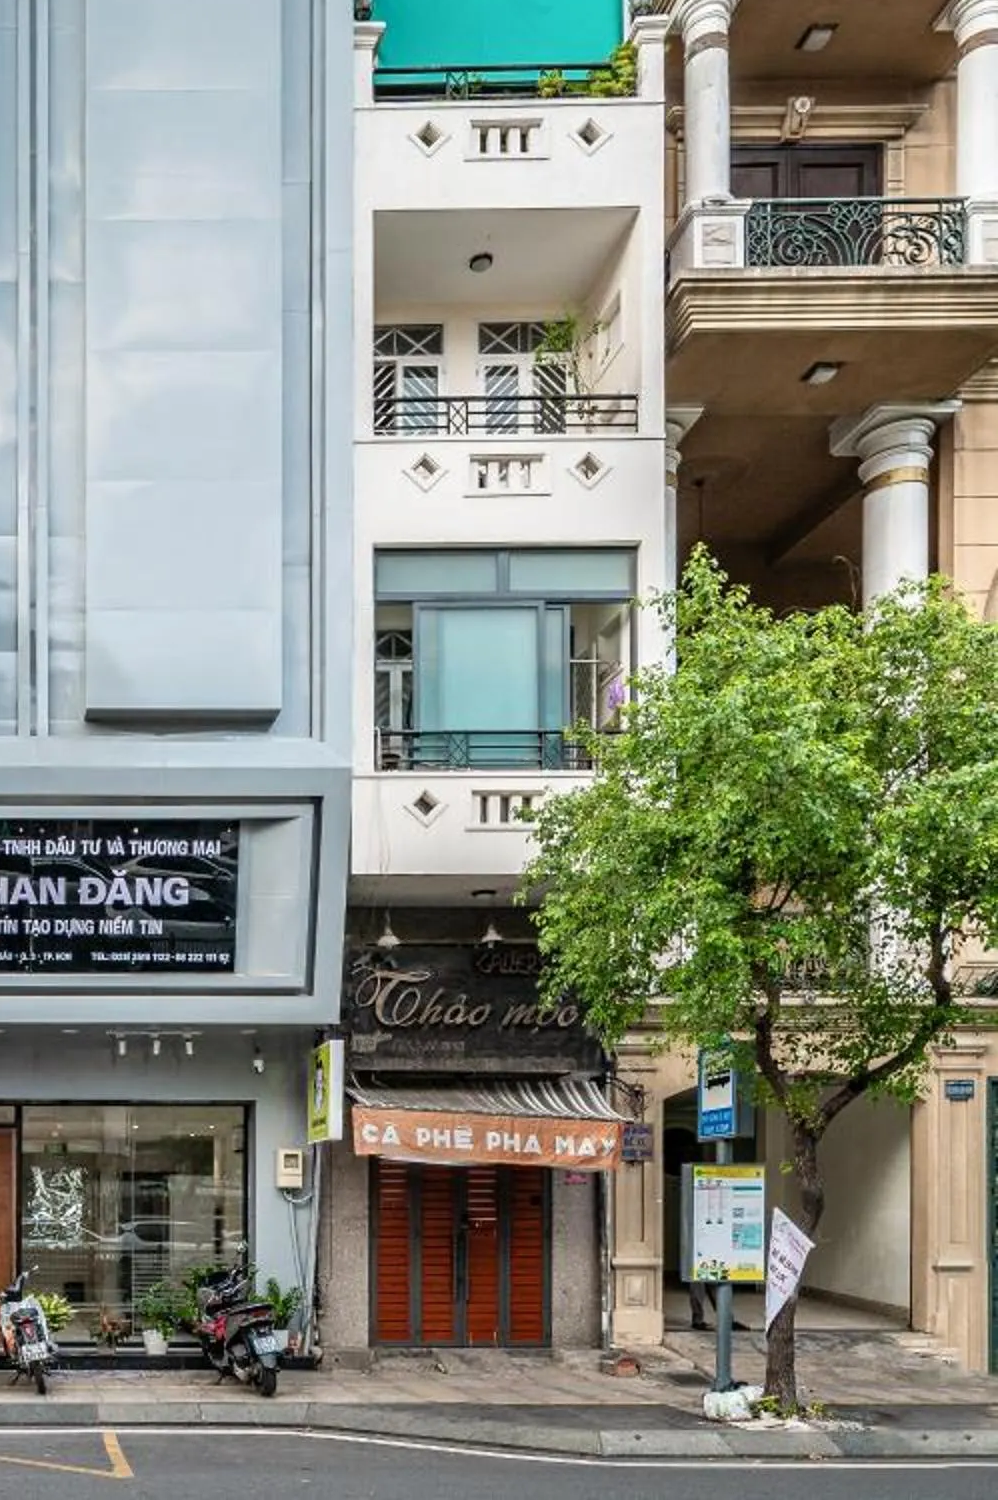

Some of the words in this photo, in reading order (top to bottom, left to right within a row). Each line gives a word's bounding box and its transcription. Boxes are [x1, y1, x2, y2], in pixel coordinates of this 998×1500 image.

[2, 840, 40, 855] TNHH
[45, 836, 75, 856] ĐẦU
[81, 838, 102, 856] TƯ
[107, 836, 125, 856] VÀ
[129, 838, 188, 856] THƯƠNG
[77, 869, 190, 907] ĐĂNG
[25, 919, 51, 937] TẠO
[54, 919, 94, 938] DỰNG
[139, 919, 163, 935] TIN
[416, 1125, 474, 1149] PHÊ
[486, 1131, 541, 1155] PHA
